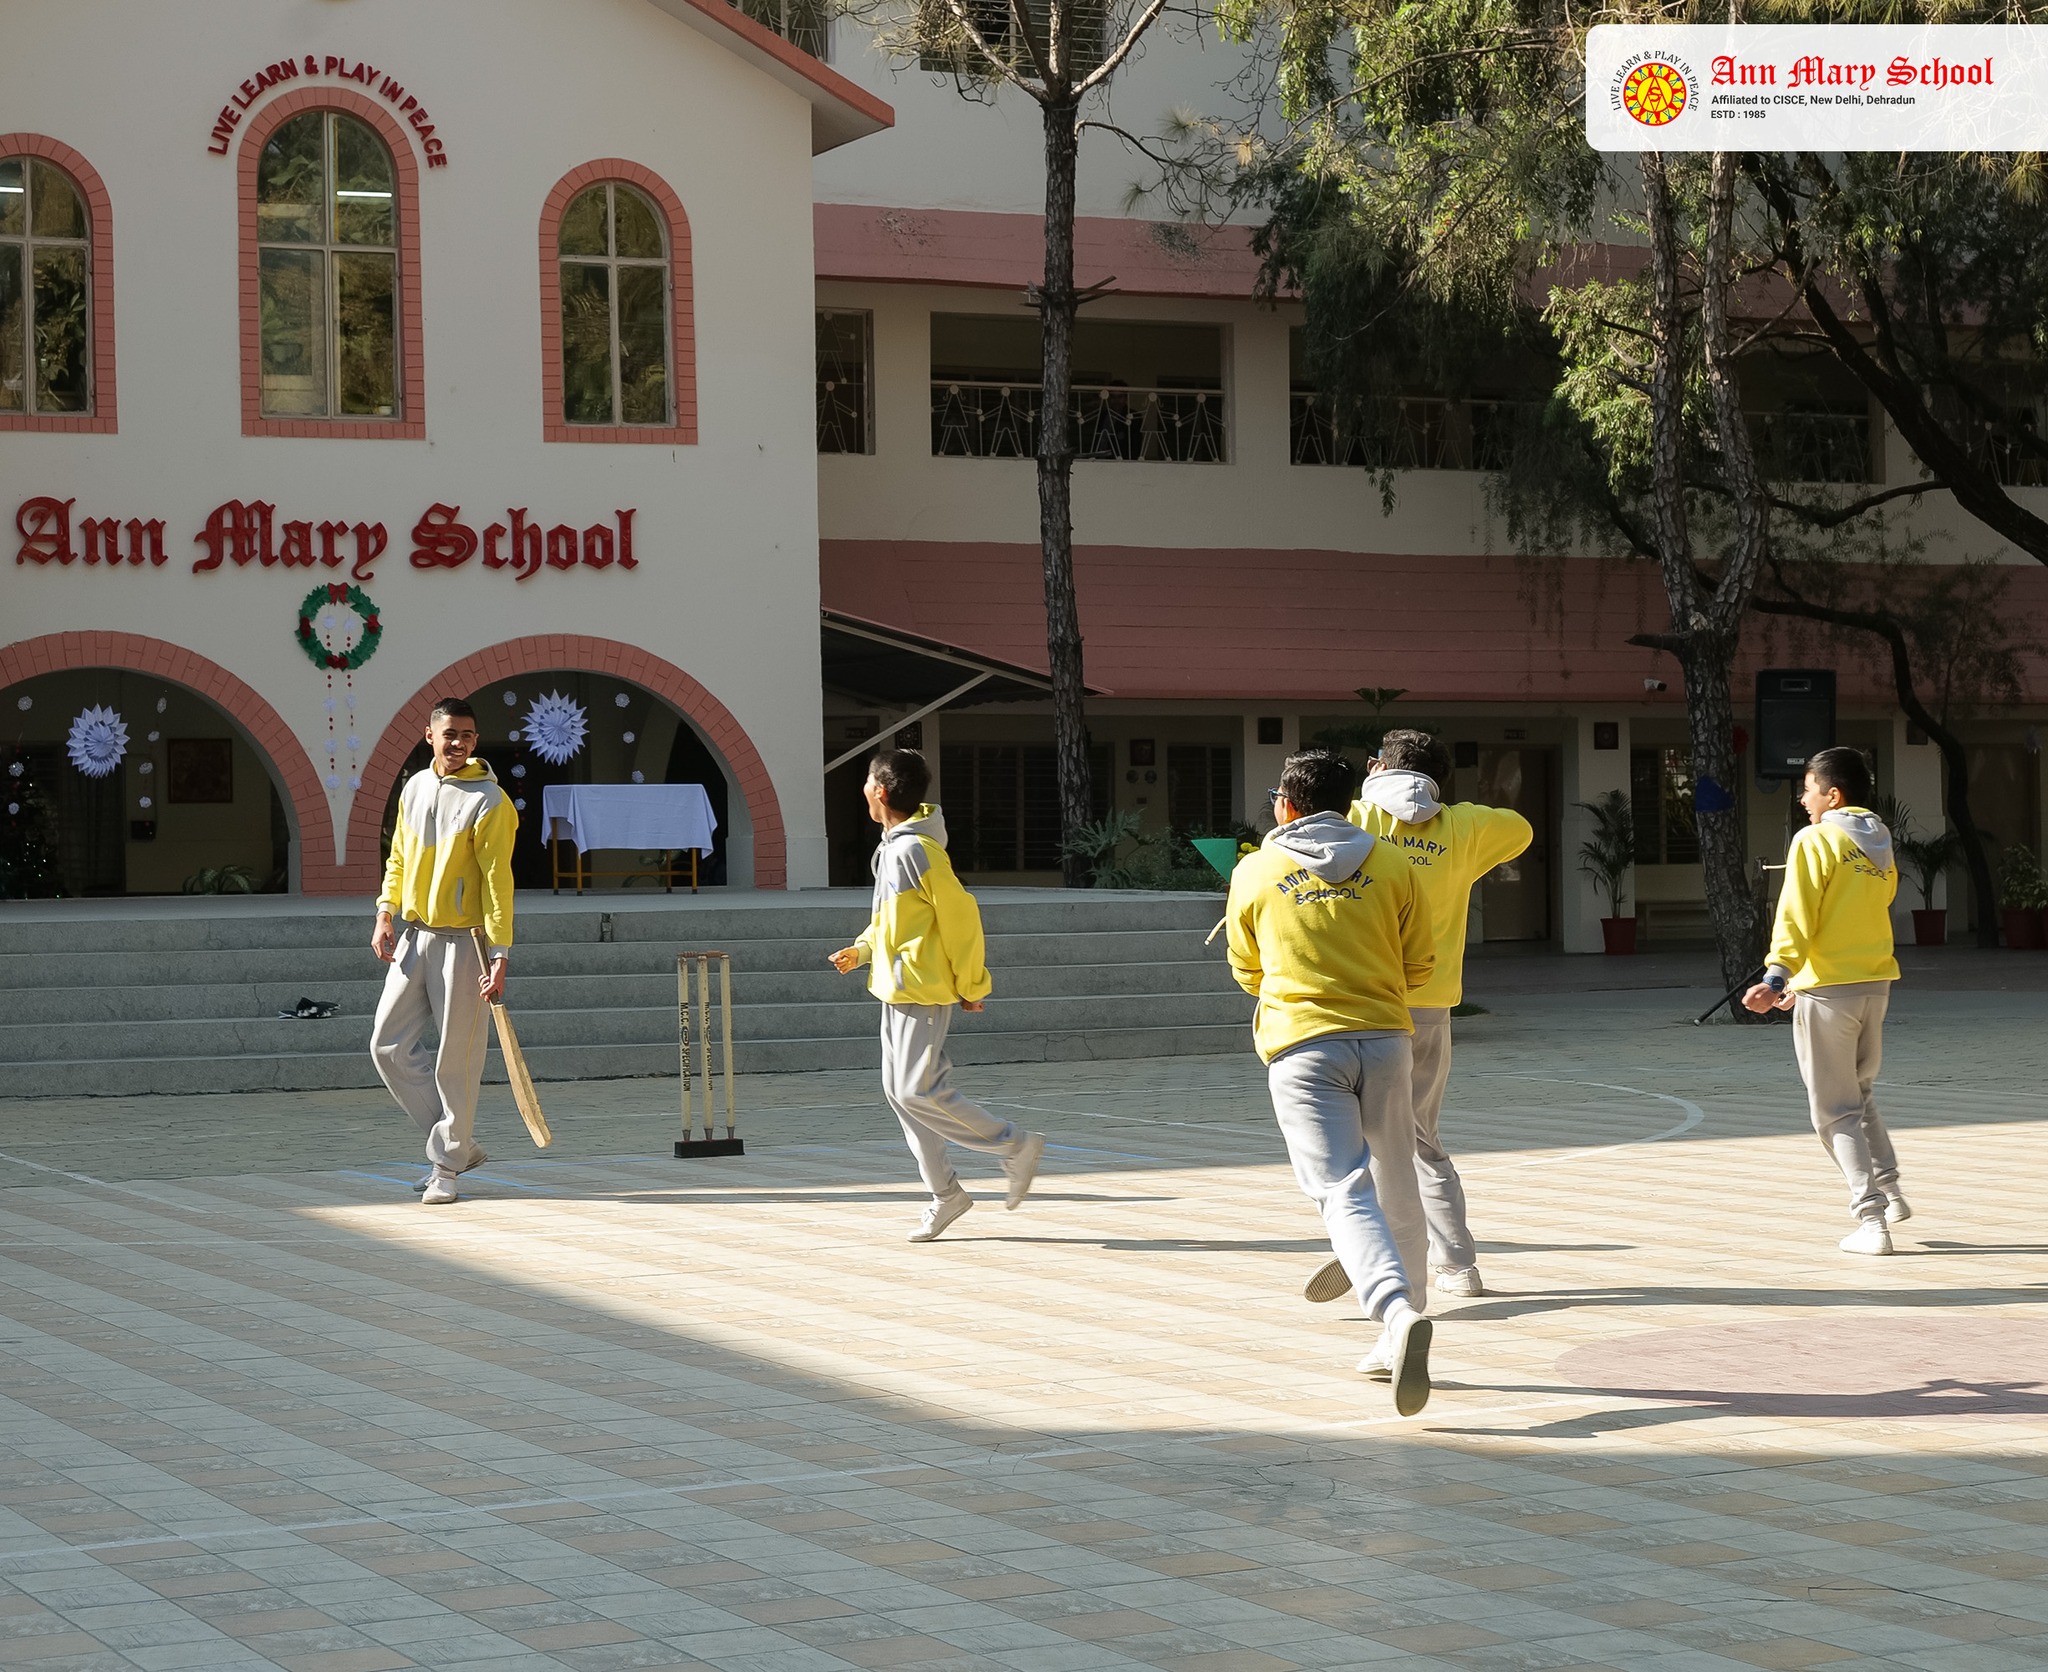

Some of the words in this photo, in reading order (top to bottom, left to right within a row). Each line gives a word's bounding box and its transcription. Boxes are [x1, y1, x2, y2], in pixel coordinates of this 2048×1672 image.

[207, 104, 242, 156] LIVE
[231, 58, 299, 110] LEARN
[304, 54, 319, 75] &
[324, 55, 381, 86] PLAY
[378, 76, 404, 103] IN
[398, 95, 447, 169] PEACE
[15, 496, 169, 568] Ann
[192, 498, 388, 581] Mary
[409, 501, 640, 582] School
[1403, 836, 1448, 856] MARY
[1276, 868, 1311, 895] ANN
[1351, 869, 1374, 889] RY
[1295, 887, 1362, 905] SCHOOL
[681, 1047, 691, 1091] SPECIFICATION
